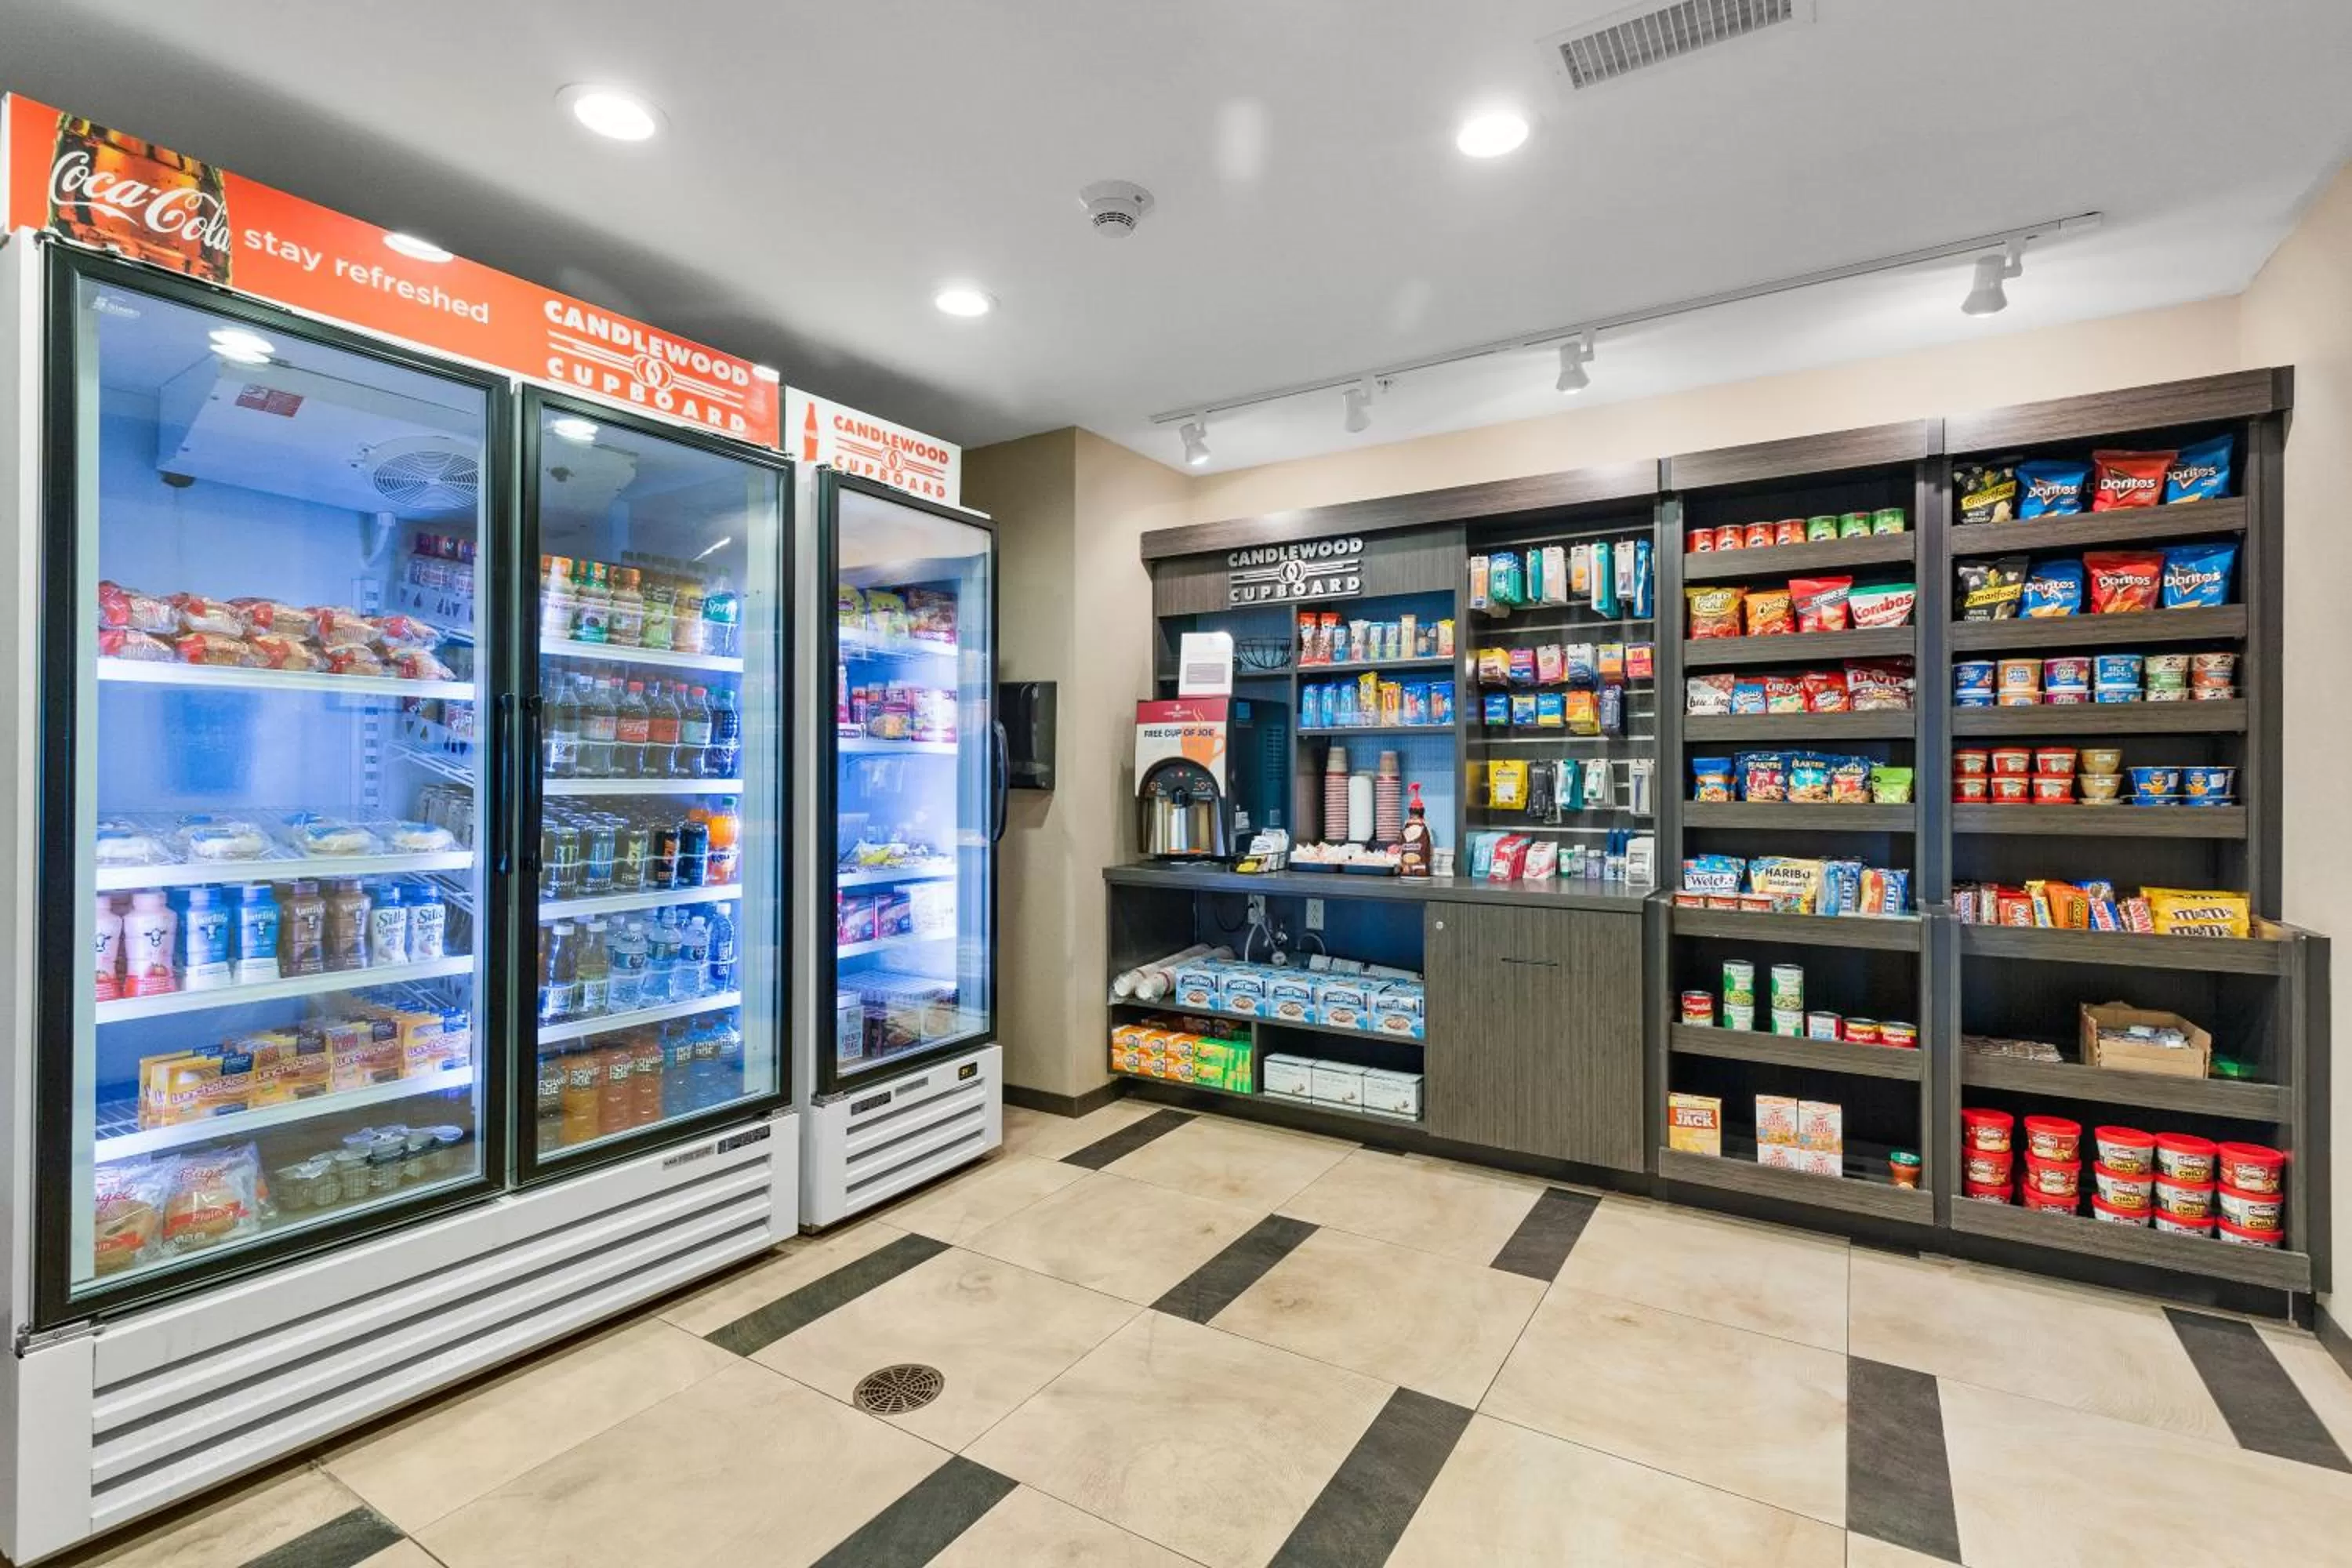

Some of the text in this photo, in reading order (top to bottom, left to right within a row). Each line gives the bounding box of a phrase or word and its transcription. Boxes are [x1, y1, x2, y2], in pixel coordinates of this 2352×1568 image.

[243, 227, 490, 324] stay refreshed
[544, 300, 750, 387] CANDLEWOOD
[546, 357, 747, 433] CUPBOARD
[833, 414, 949, 465] CANDLEWOOD
[834, 454, 947, 499] CUPBOARD
[2100, 478, 2155, 490] Doritos
[2027, 485, 2078, 498] Doritos
[1228, 537, 1363, 567] CANDLEWOOD
[1229, 576, 1361, 601] CUPBOARD
[2024, 580, 2075, 592] Doritos
[2099, 575, 2151, 587] Doritos
[2164, 572, 2221, 586] Doritos
[1854, 592, 1912, 620] Combos
[1144, 729, 1163, 738] FREE
[1676, 1115, 1715, 1128] JACK
